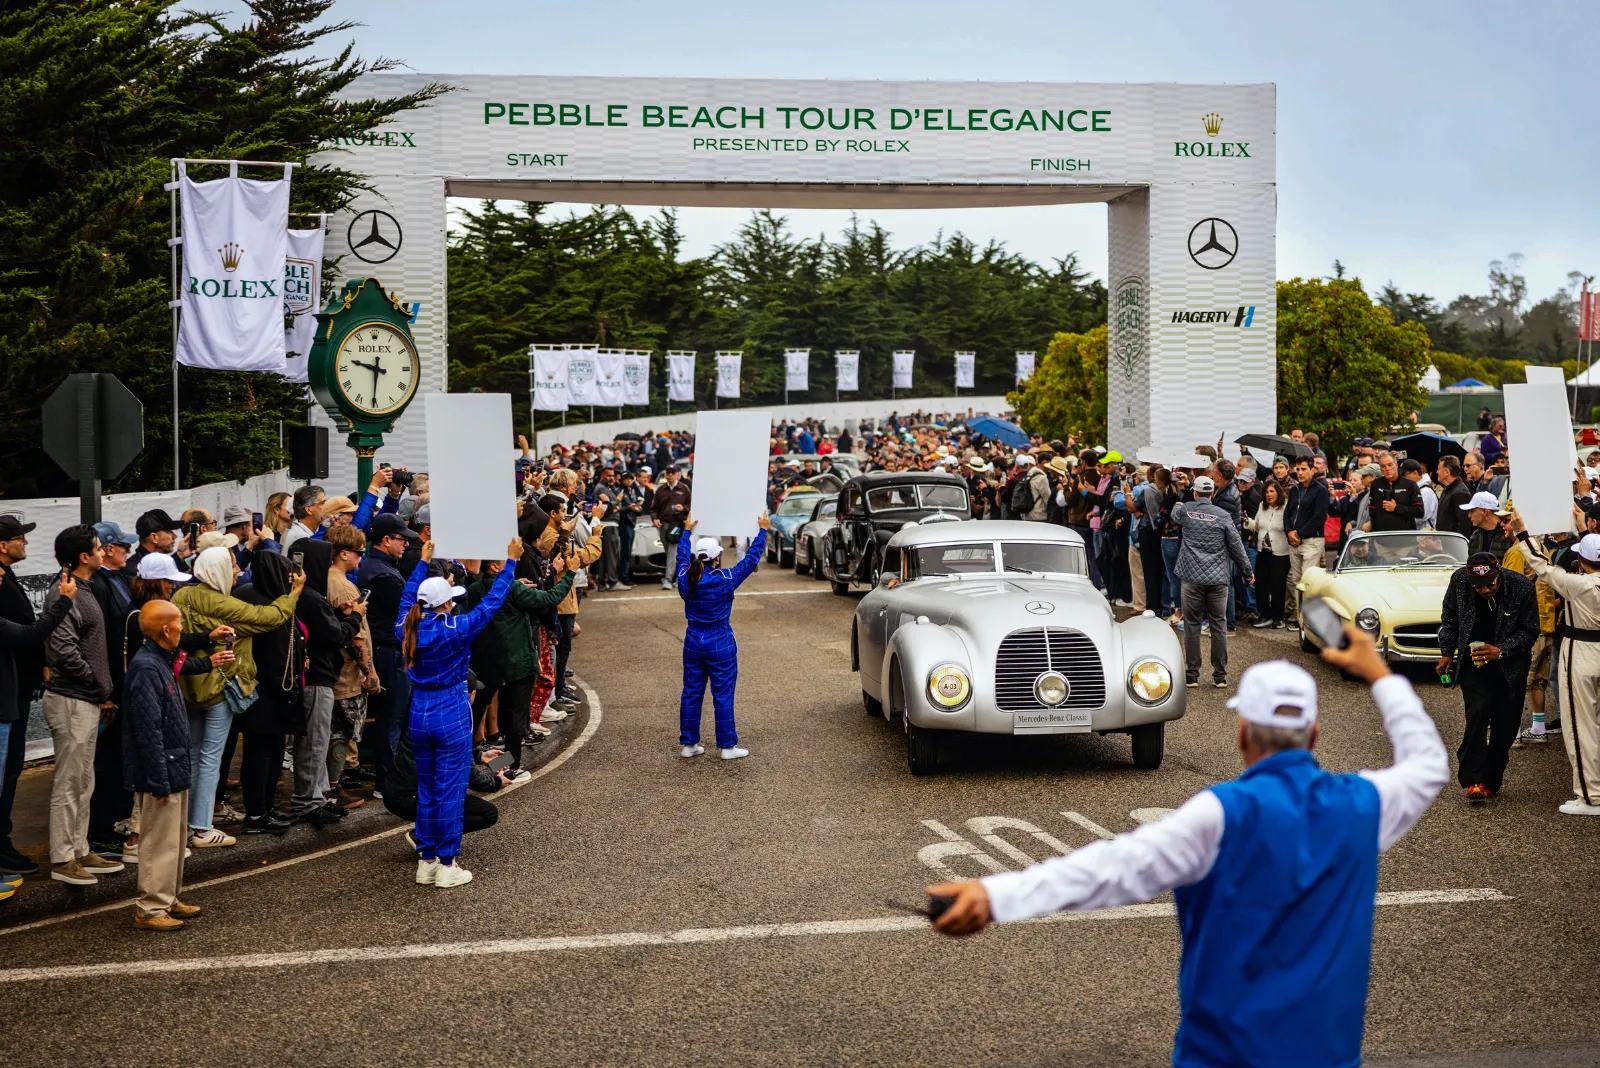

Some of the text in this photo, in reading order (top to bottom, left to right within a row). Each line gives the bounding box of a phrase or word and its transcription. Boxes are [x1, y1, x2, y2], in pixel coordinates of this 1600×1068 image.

[484, 102, 629, 127] PEBBLE
[642, 104, 765, 129] BEACH
[775, 106, 876, 131] TOUR
[692, 138, 911, 153] PRESENTED BY ROLEX
[1174, 142, 1251, 159] ROLEX
[506, 153, 569, 167] START
[1030, 157, 1091, 172] FINISH
[188, 276, 278, 298] ROLEX
[1172, 311, 1231, 323] HAGERTY
[358, 345, 391, 353] ROLEX
[535, 381, 566, 389] ROLEX
[1018, 713, 1088, 723] Mercedes-Benz Classic
